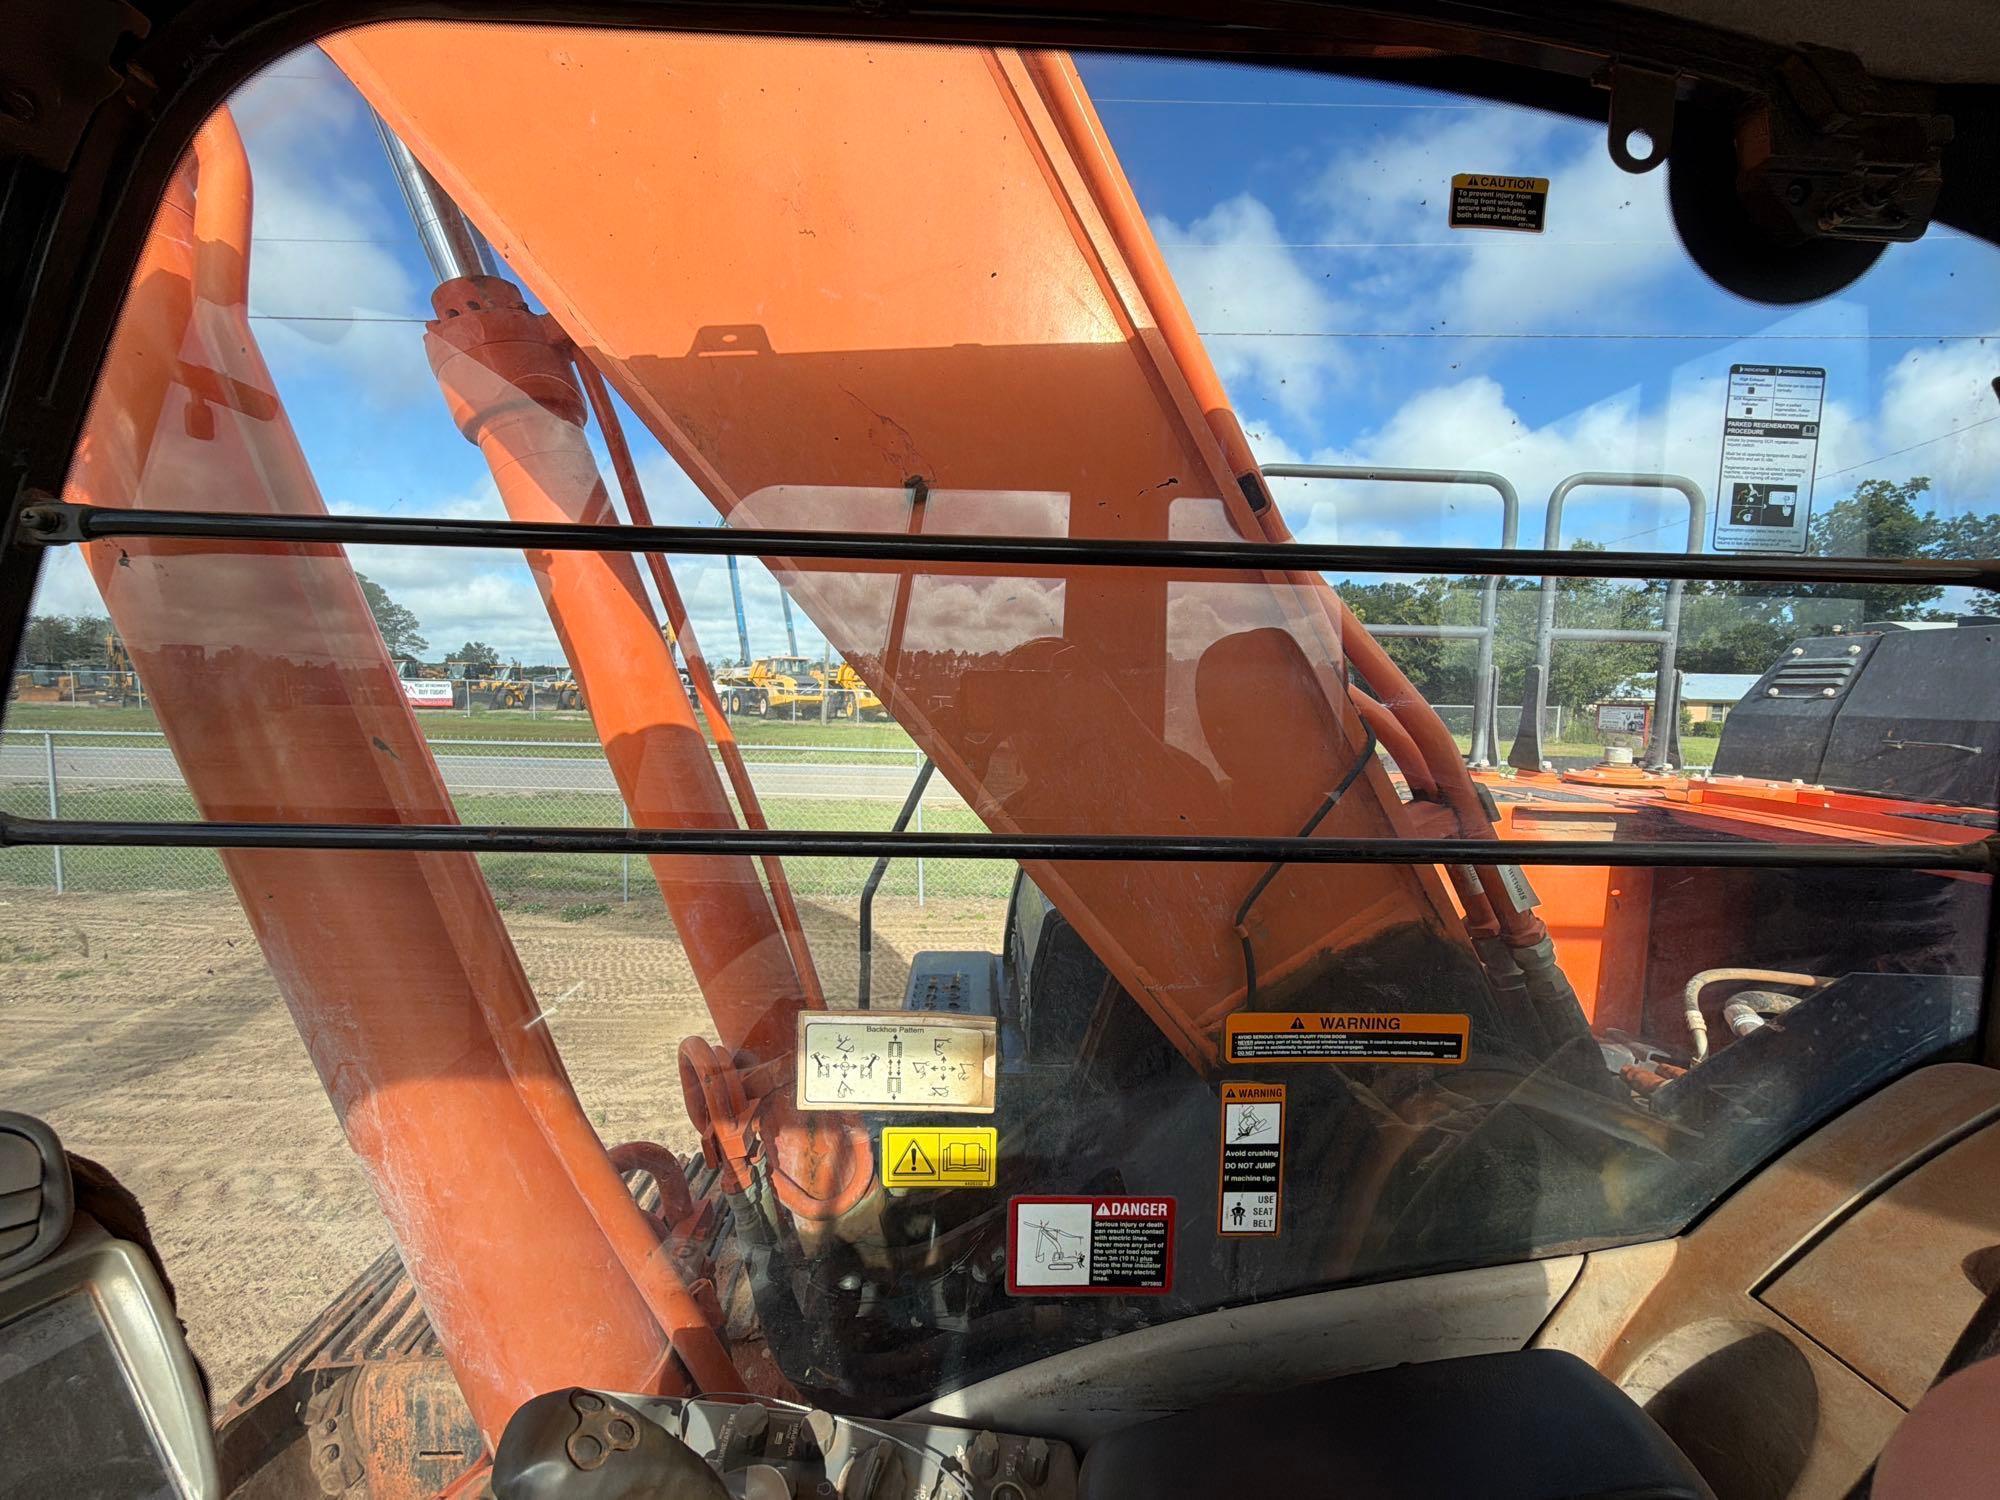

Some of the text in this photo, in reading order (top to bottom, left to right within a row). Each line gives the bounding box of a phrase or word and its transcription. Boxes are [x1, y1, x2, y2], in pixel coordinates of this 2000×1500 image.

[1481, 177, 1535, 190] CAUTION
[1468, 190, 1494, 198] prevent
[1496, 191, 1514, 200] injury
[1458, 197, 1478, 205] falling
[1512, 208, 1526, 216] pins
[1753, 422, 1800, 430] REGENERATION
[1320, 1017, 1401, 1030] WARNING
[866, 1025, 925, 1034] Backhoe Pattern
[1238, 1088, 1282, 1098] WARNING
[1248, 1150, 1279, 1158] crushing
[1258, 1196, 1274, 1204] USE
[1111, 1202, 1168, 1216] DANGER
[1253, 1208, 1273, 1216] SEAT
[1253, 1220, 1273, 1228] BELT
